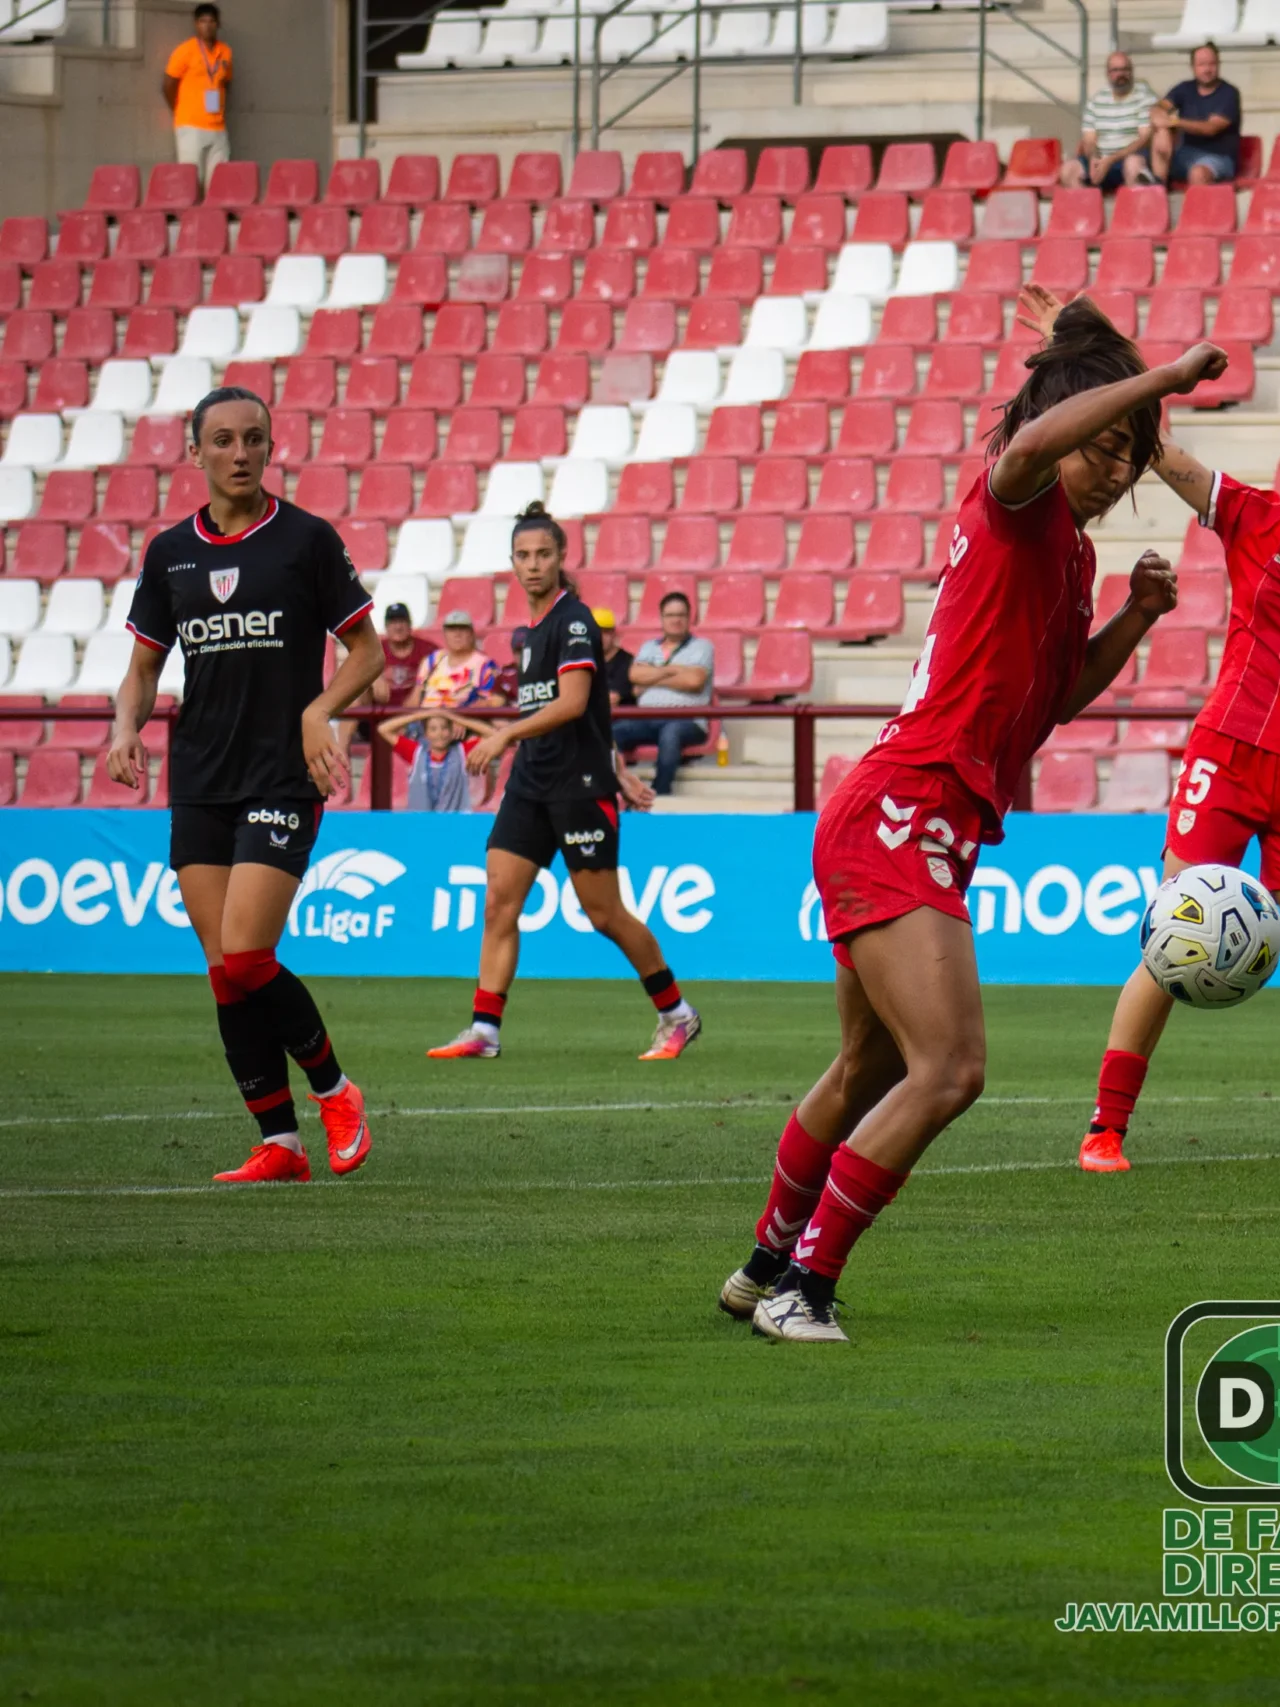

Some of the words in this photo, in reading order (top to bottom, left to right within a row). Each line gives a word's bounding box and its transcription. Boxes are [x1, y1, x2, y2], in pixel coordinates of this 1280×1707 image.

[247, 639, 284, 650] eficiente
[1173, 757, 1218, 805] 5
[0, 857, 196, 928] oeve
[305, 903, 370, 944] Liga
[374, 905, 396, 938] F
